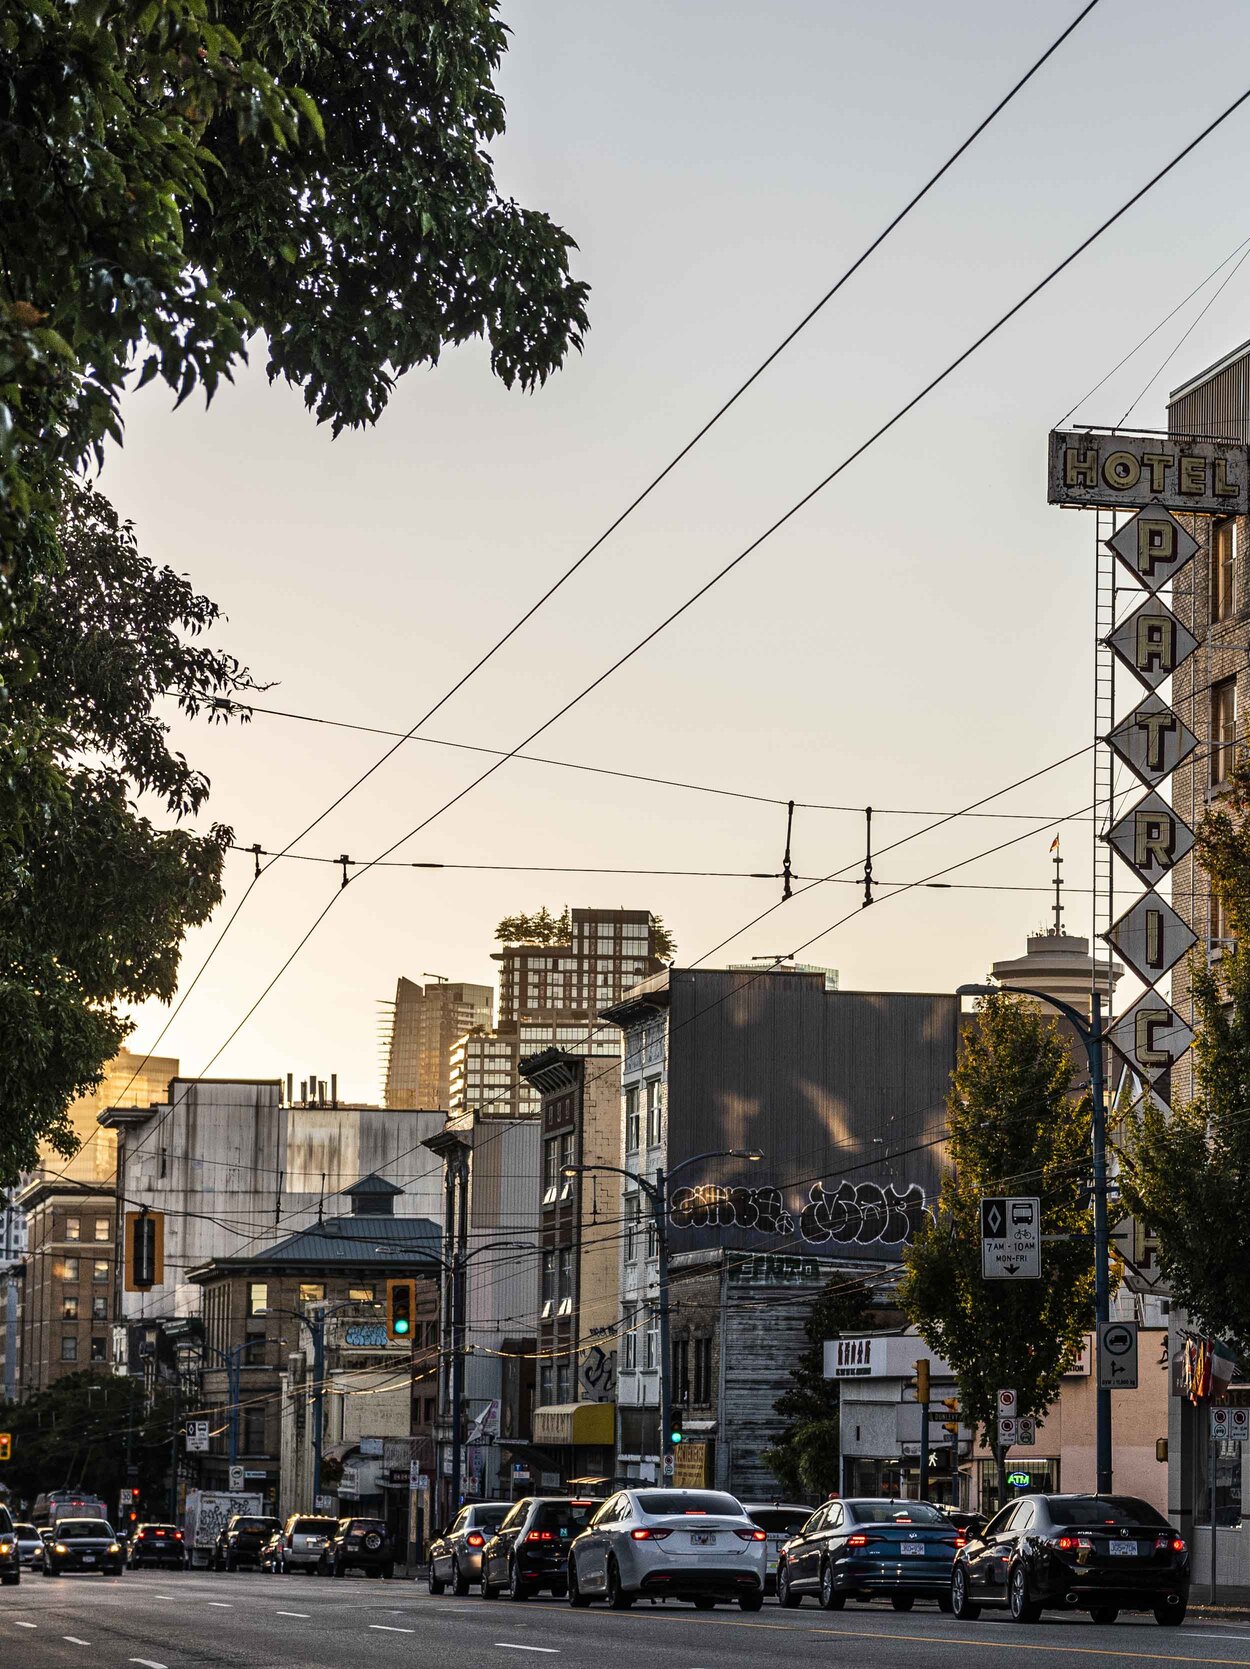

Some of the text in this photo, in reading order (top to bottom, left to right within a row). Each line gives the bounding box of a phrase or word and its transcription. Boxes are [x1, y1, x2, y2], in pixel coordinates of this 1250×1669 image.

[1064, 447, 1241, 498] HOTEL
[996, 1254, 1027, 1262] MON-FRI
[1008, 1475, 1031, 1485] ATM
